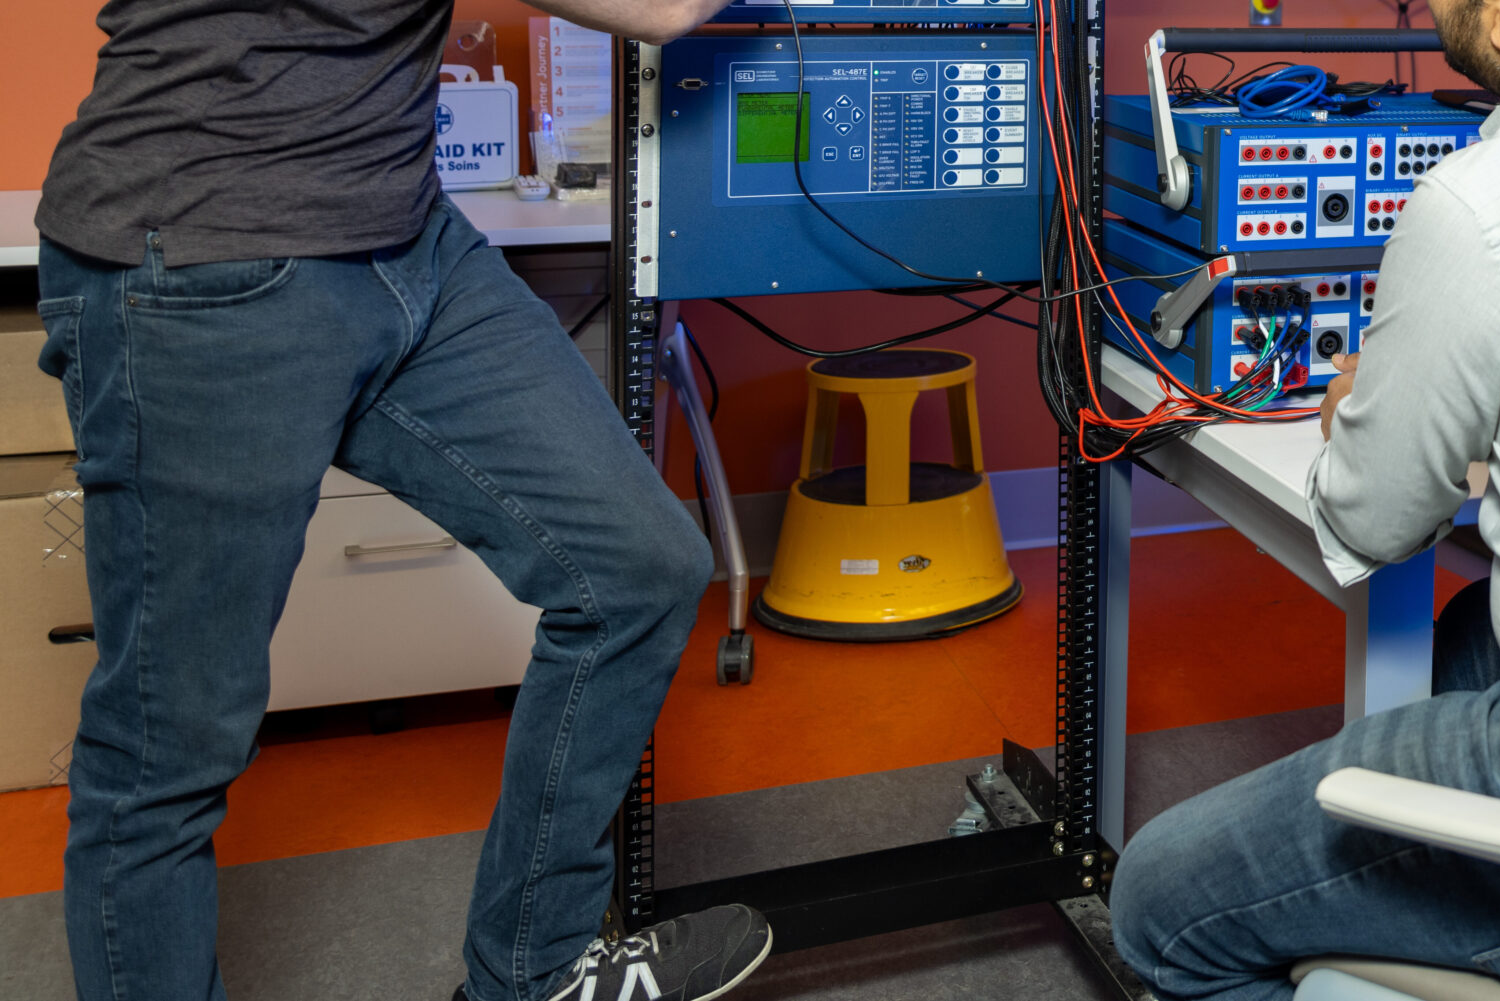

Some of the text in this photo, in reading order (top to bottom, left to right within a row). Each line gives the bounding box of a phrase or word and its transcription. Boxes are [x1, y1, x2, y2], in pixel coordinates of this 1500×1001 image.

[554, 26, 560, 36] 1
[554, 46, 562, 57] 2
[536, 35, 549, 80] Journey
[554, 66, 562, 76] 3
[555, 87, 563, 97] 4
[556, 106, 564, 117] 5
[434, 142, 505, 158] AID KIT
[448, 161, 480, 171] Soins
